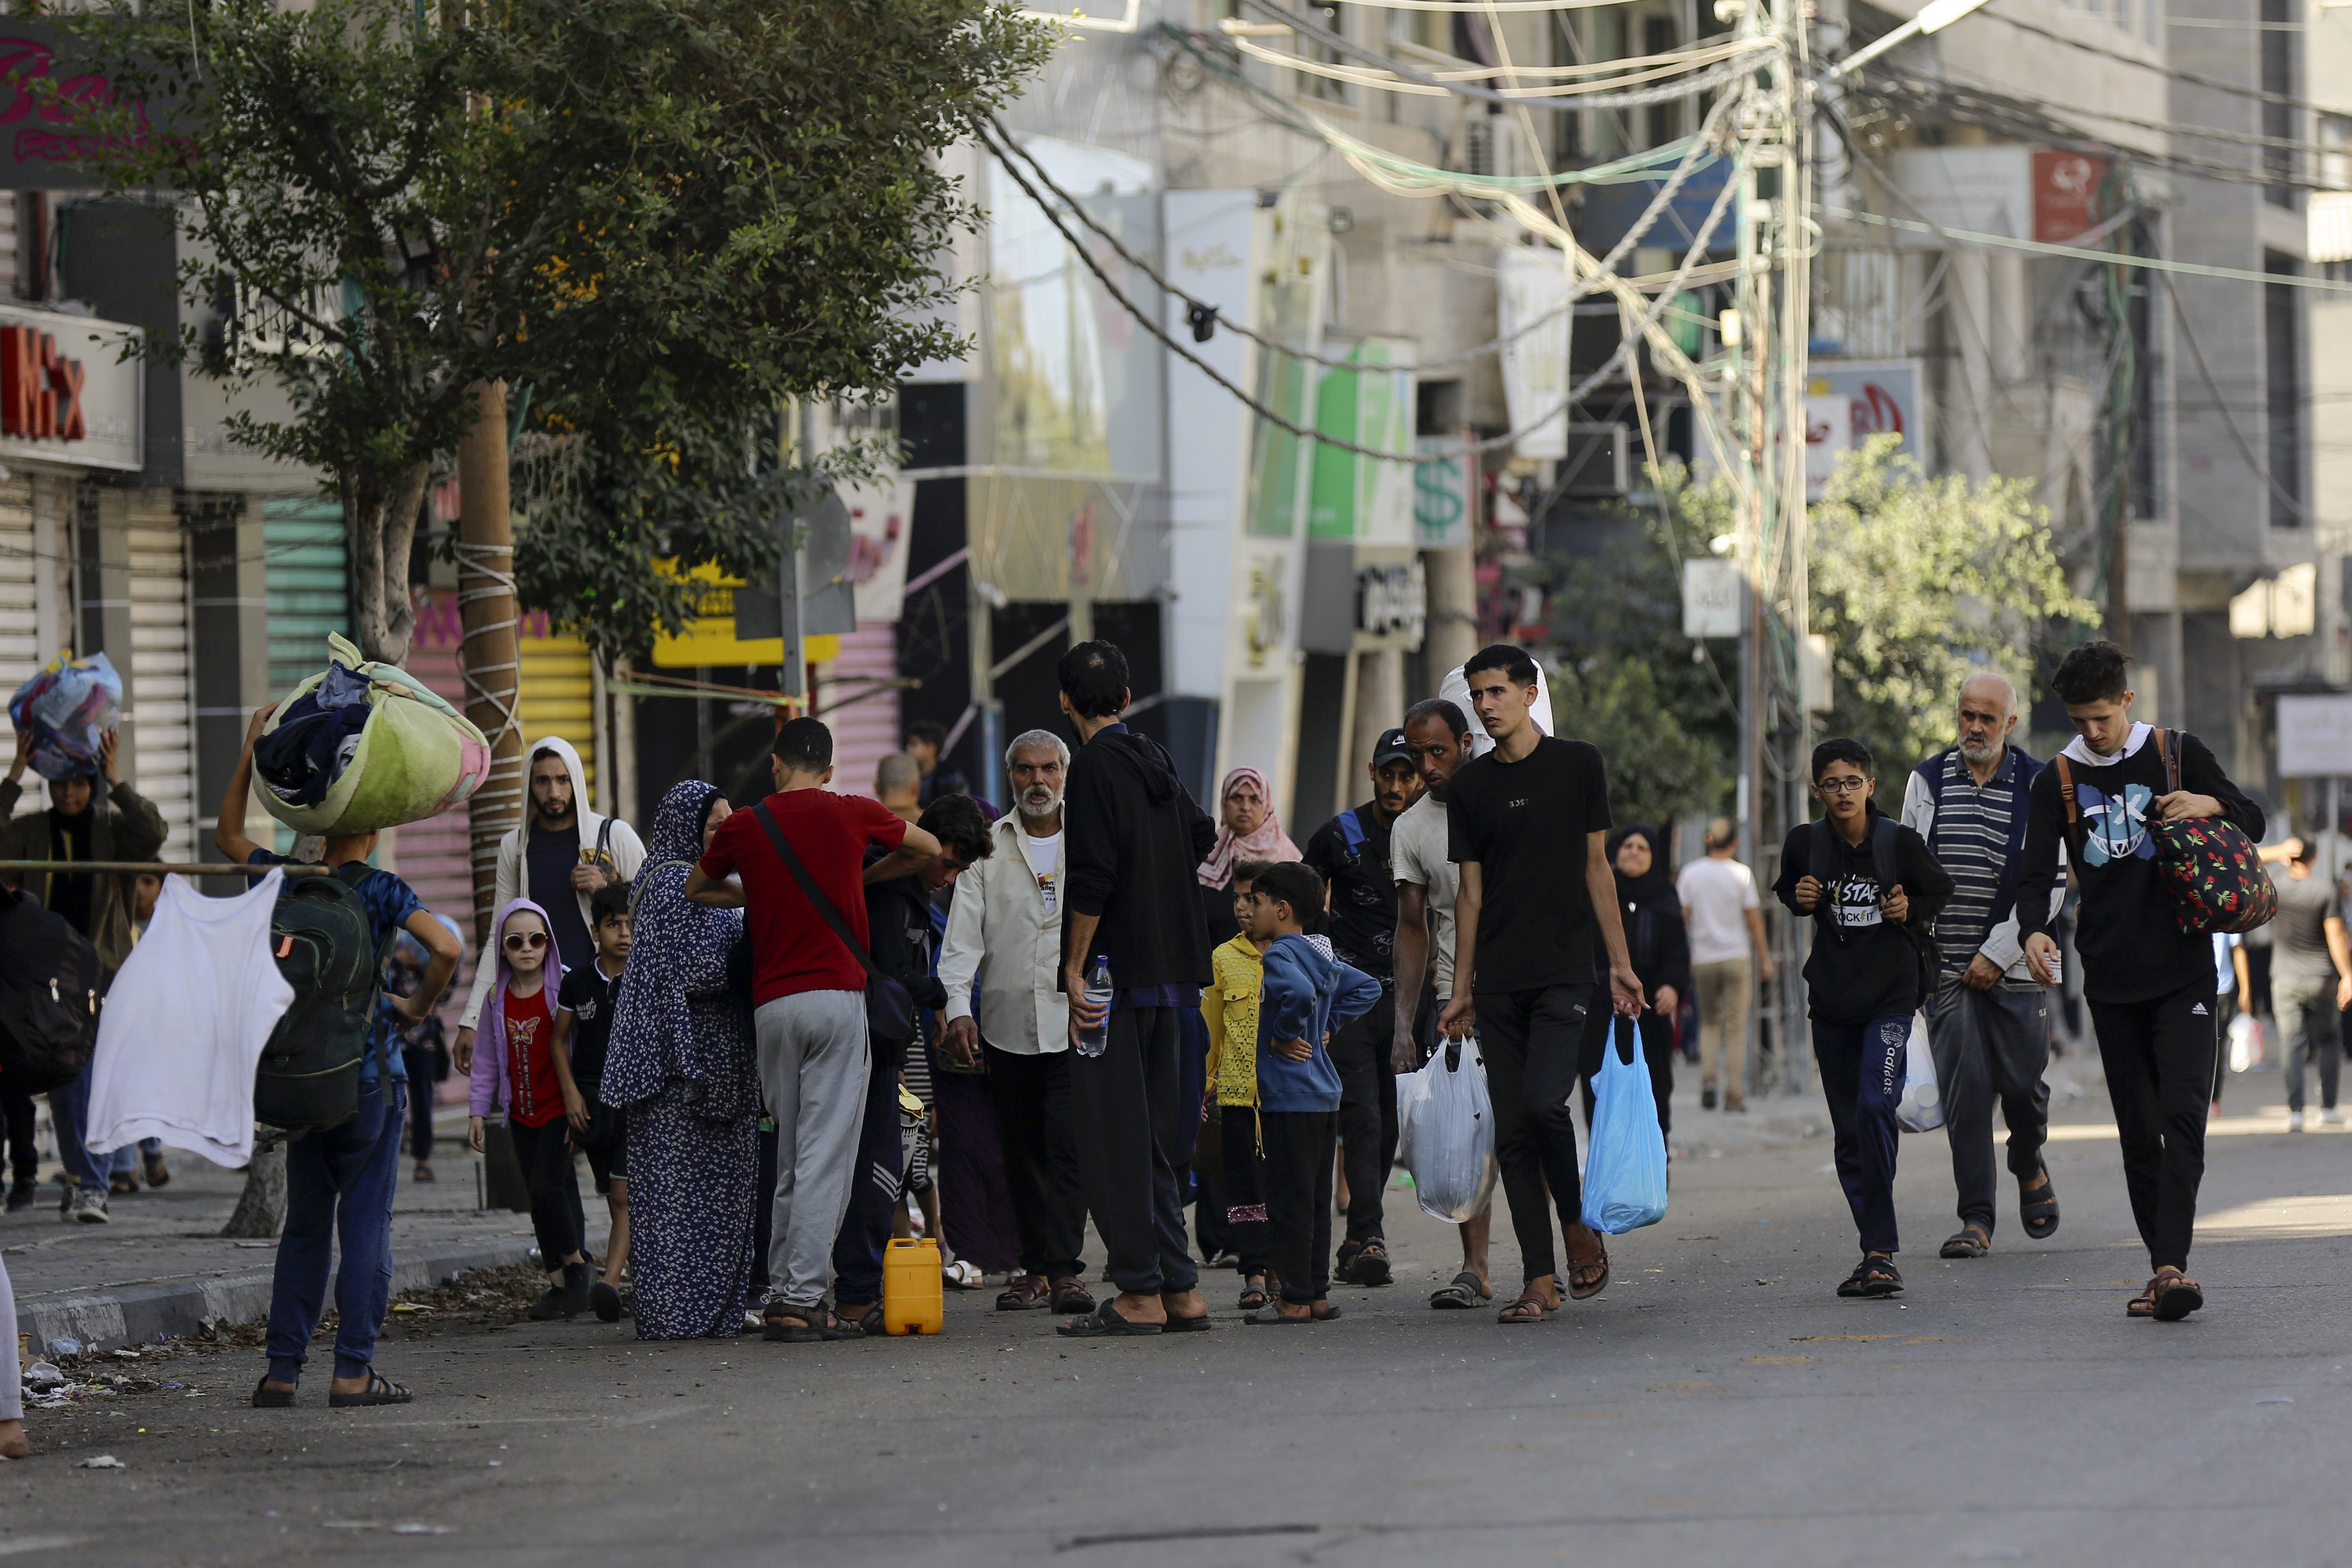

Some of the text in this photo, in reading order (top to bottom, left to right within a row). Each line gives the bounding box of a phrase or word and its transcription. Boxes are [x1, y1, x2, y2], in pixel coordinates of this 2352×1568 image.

[1842, 882, 1880, 903] STAR
[1883, 1047, 1896, 1095] adidas
[912, 1133, 931, 1190] FASHION
